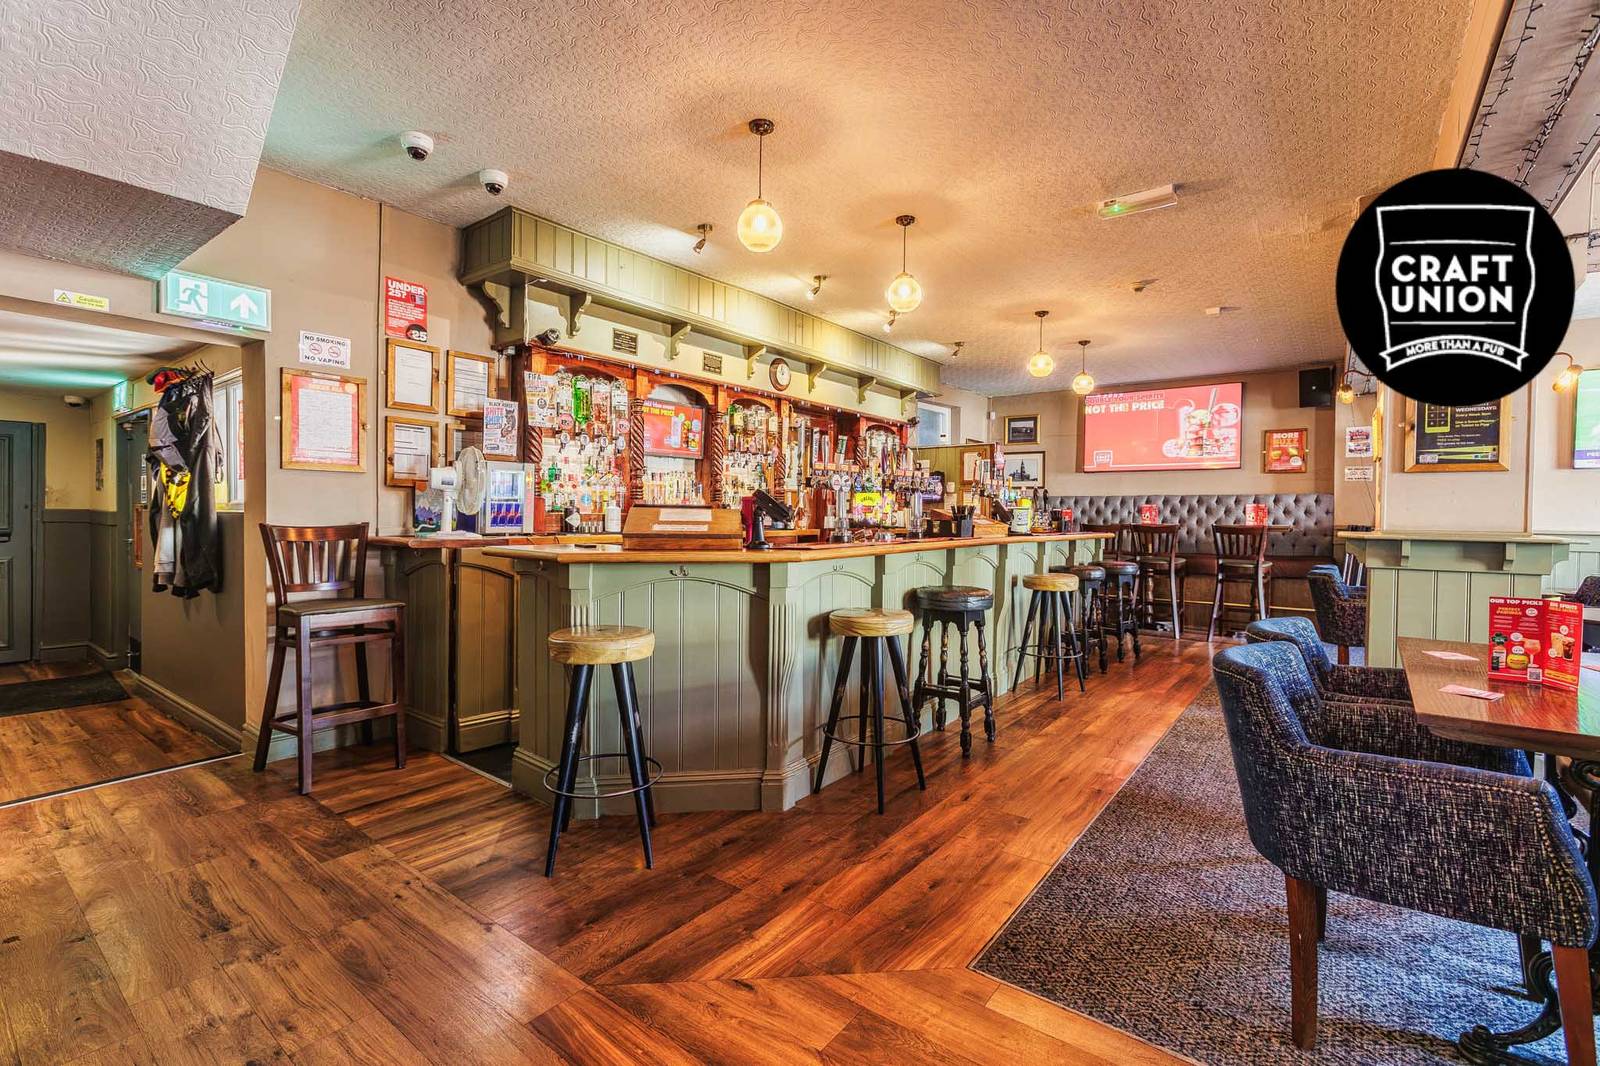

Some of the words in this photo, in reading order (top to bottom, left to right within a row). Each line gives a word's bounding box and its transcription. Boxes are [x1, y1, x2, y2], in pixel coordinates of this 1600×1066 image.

[388, 279, 425, 295] UNDER
[388, 287, 407, 299] 25?
[316, 336, 346, 347] SMOKING
[317, 356, 345, 366] VAPING
[528, 373, 542, 381] FIFA
[1085, 404, 1106, 414] NOT
[1109, 402, 1129, 413] THE
[1131, 400, 1165, 411] PRICE
